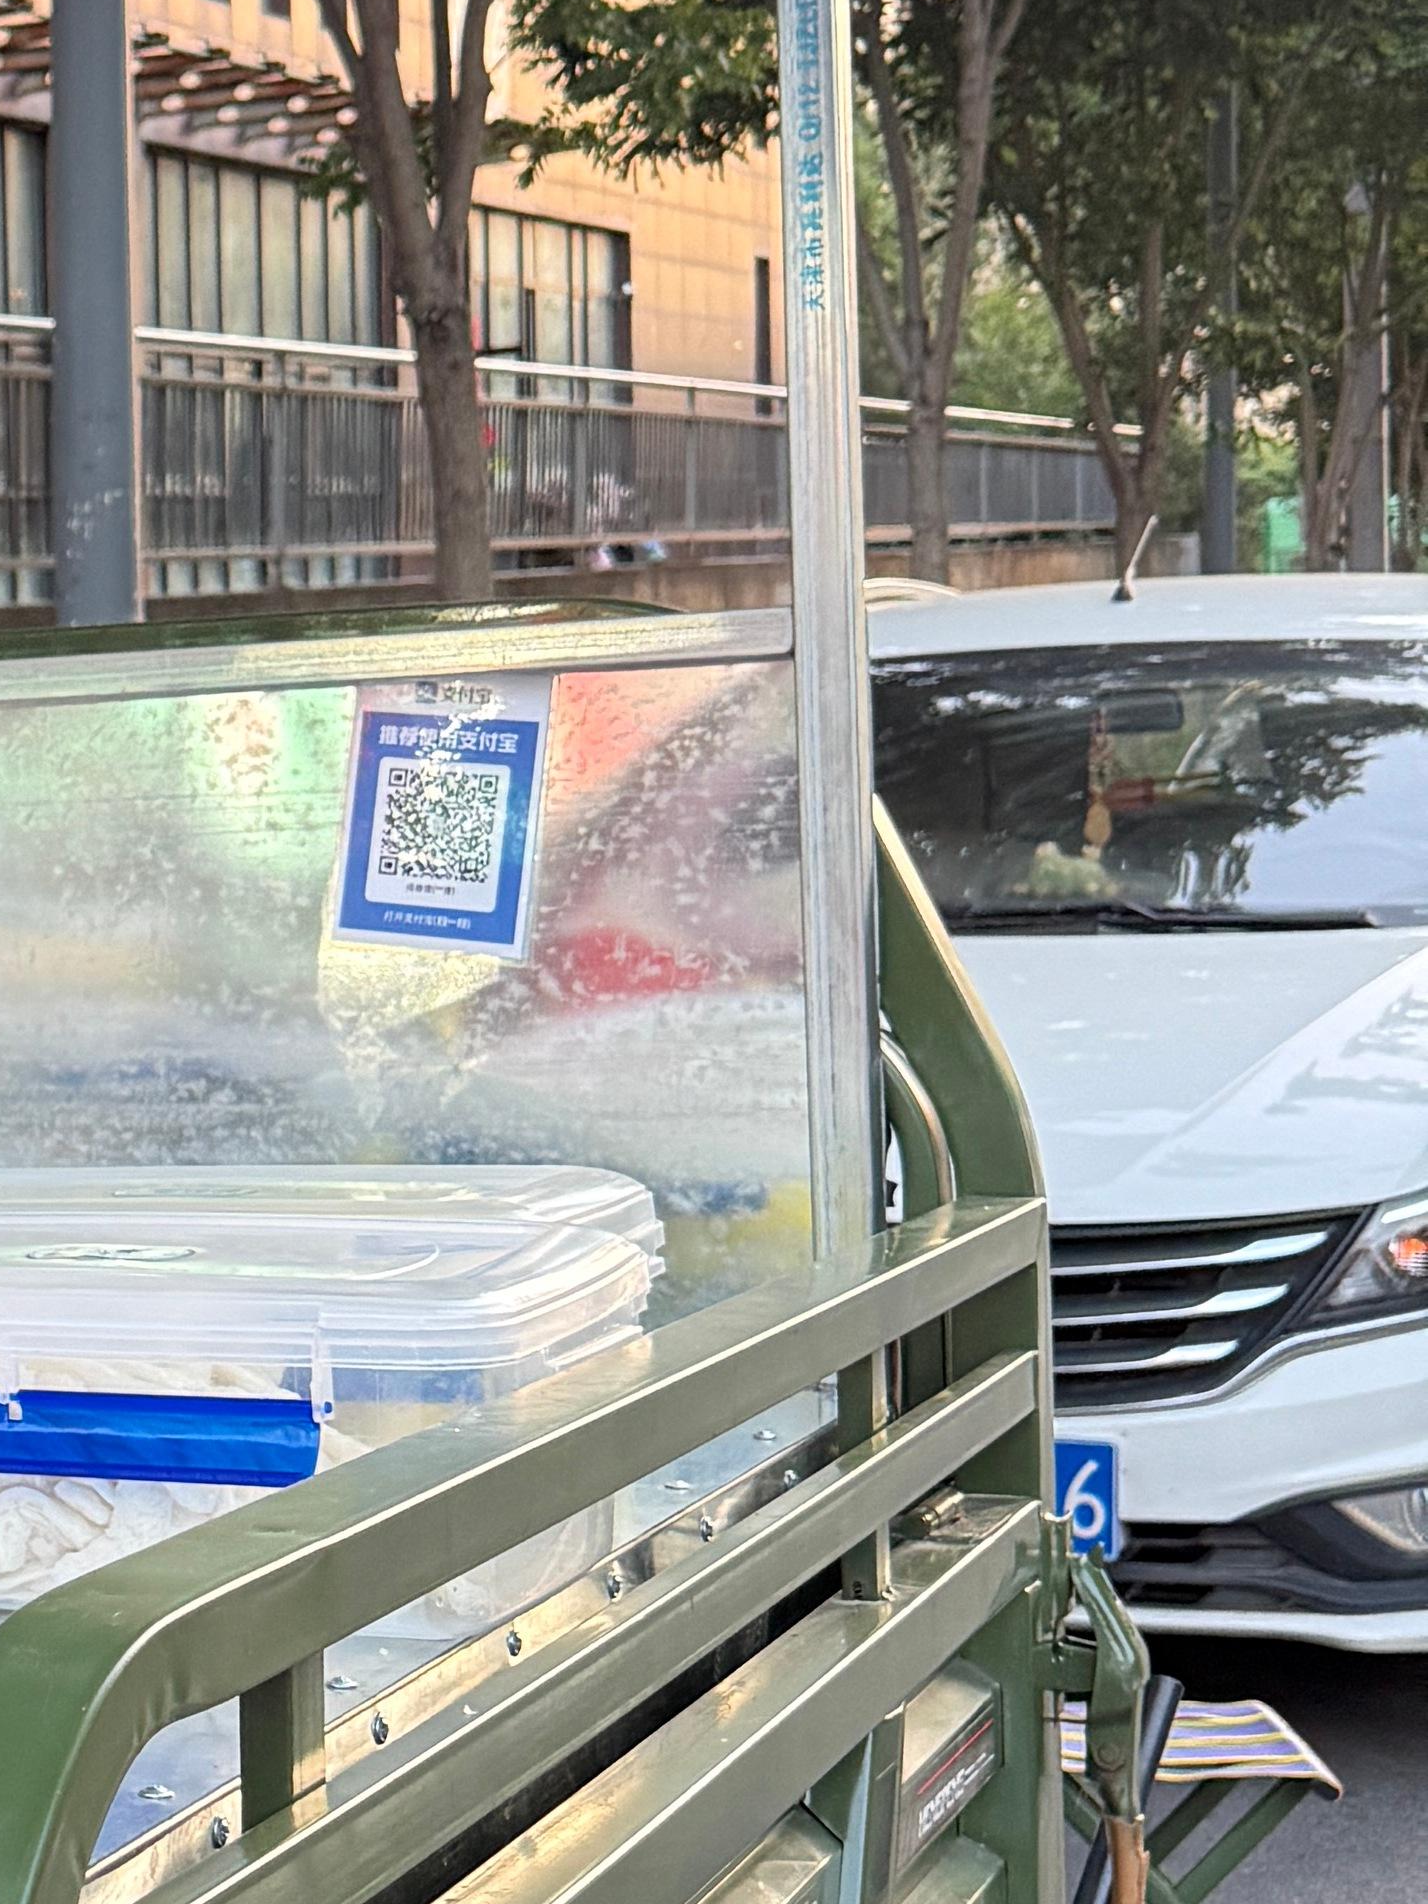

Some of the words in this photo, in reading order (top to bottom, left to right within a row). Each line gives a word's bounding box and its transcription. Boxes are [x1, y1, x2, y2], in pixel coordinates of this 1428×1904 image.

[441, 683, 494, 706] 支付宝
[378, 724, 520, 755] 推荐使用支付宝
